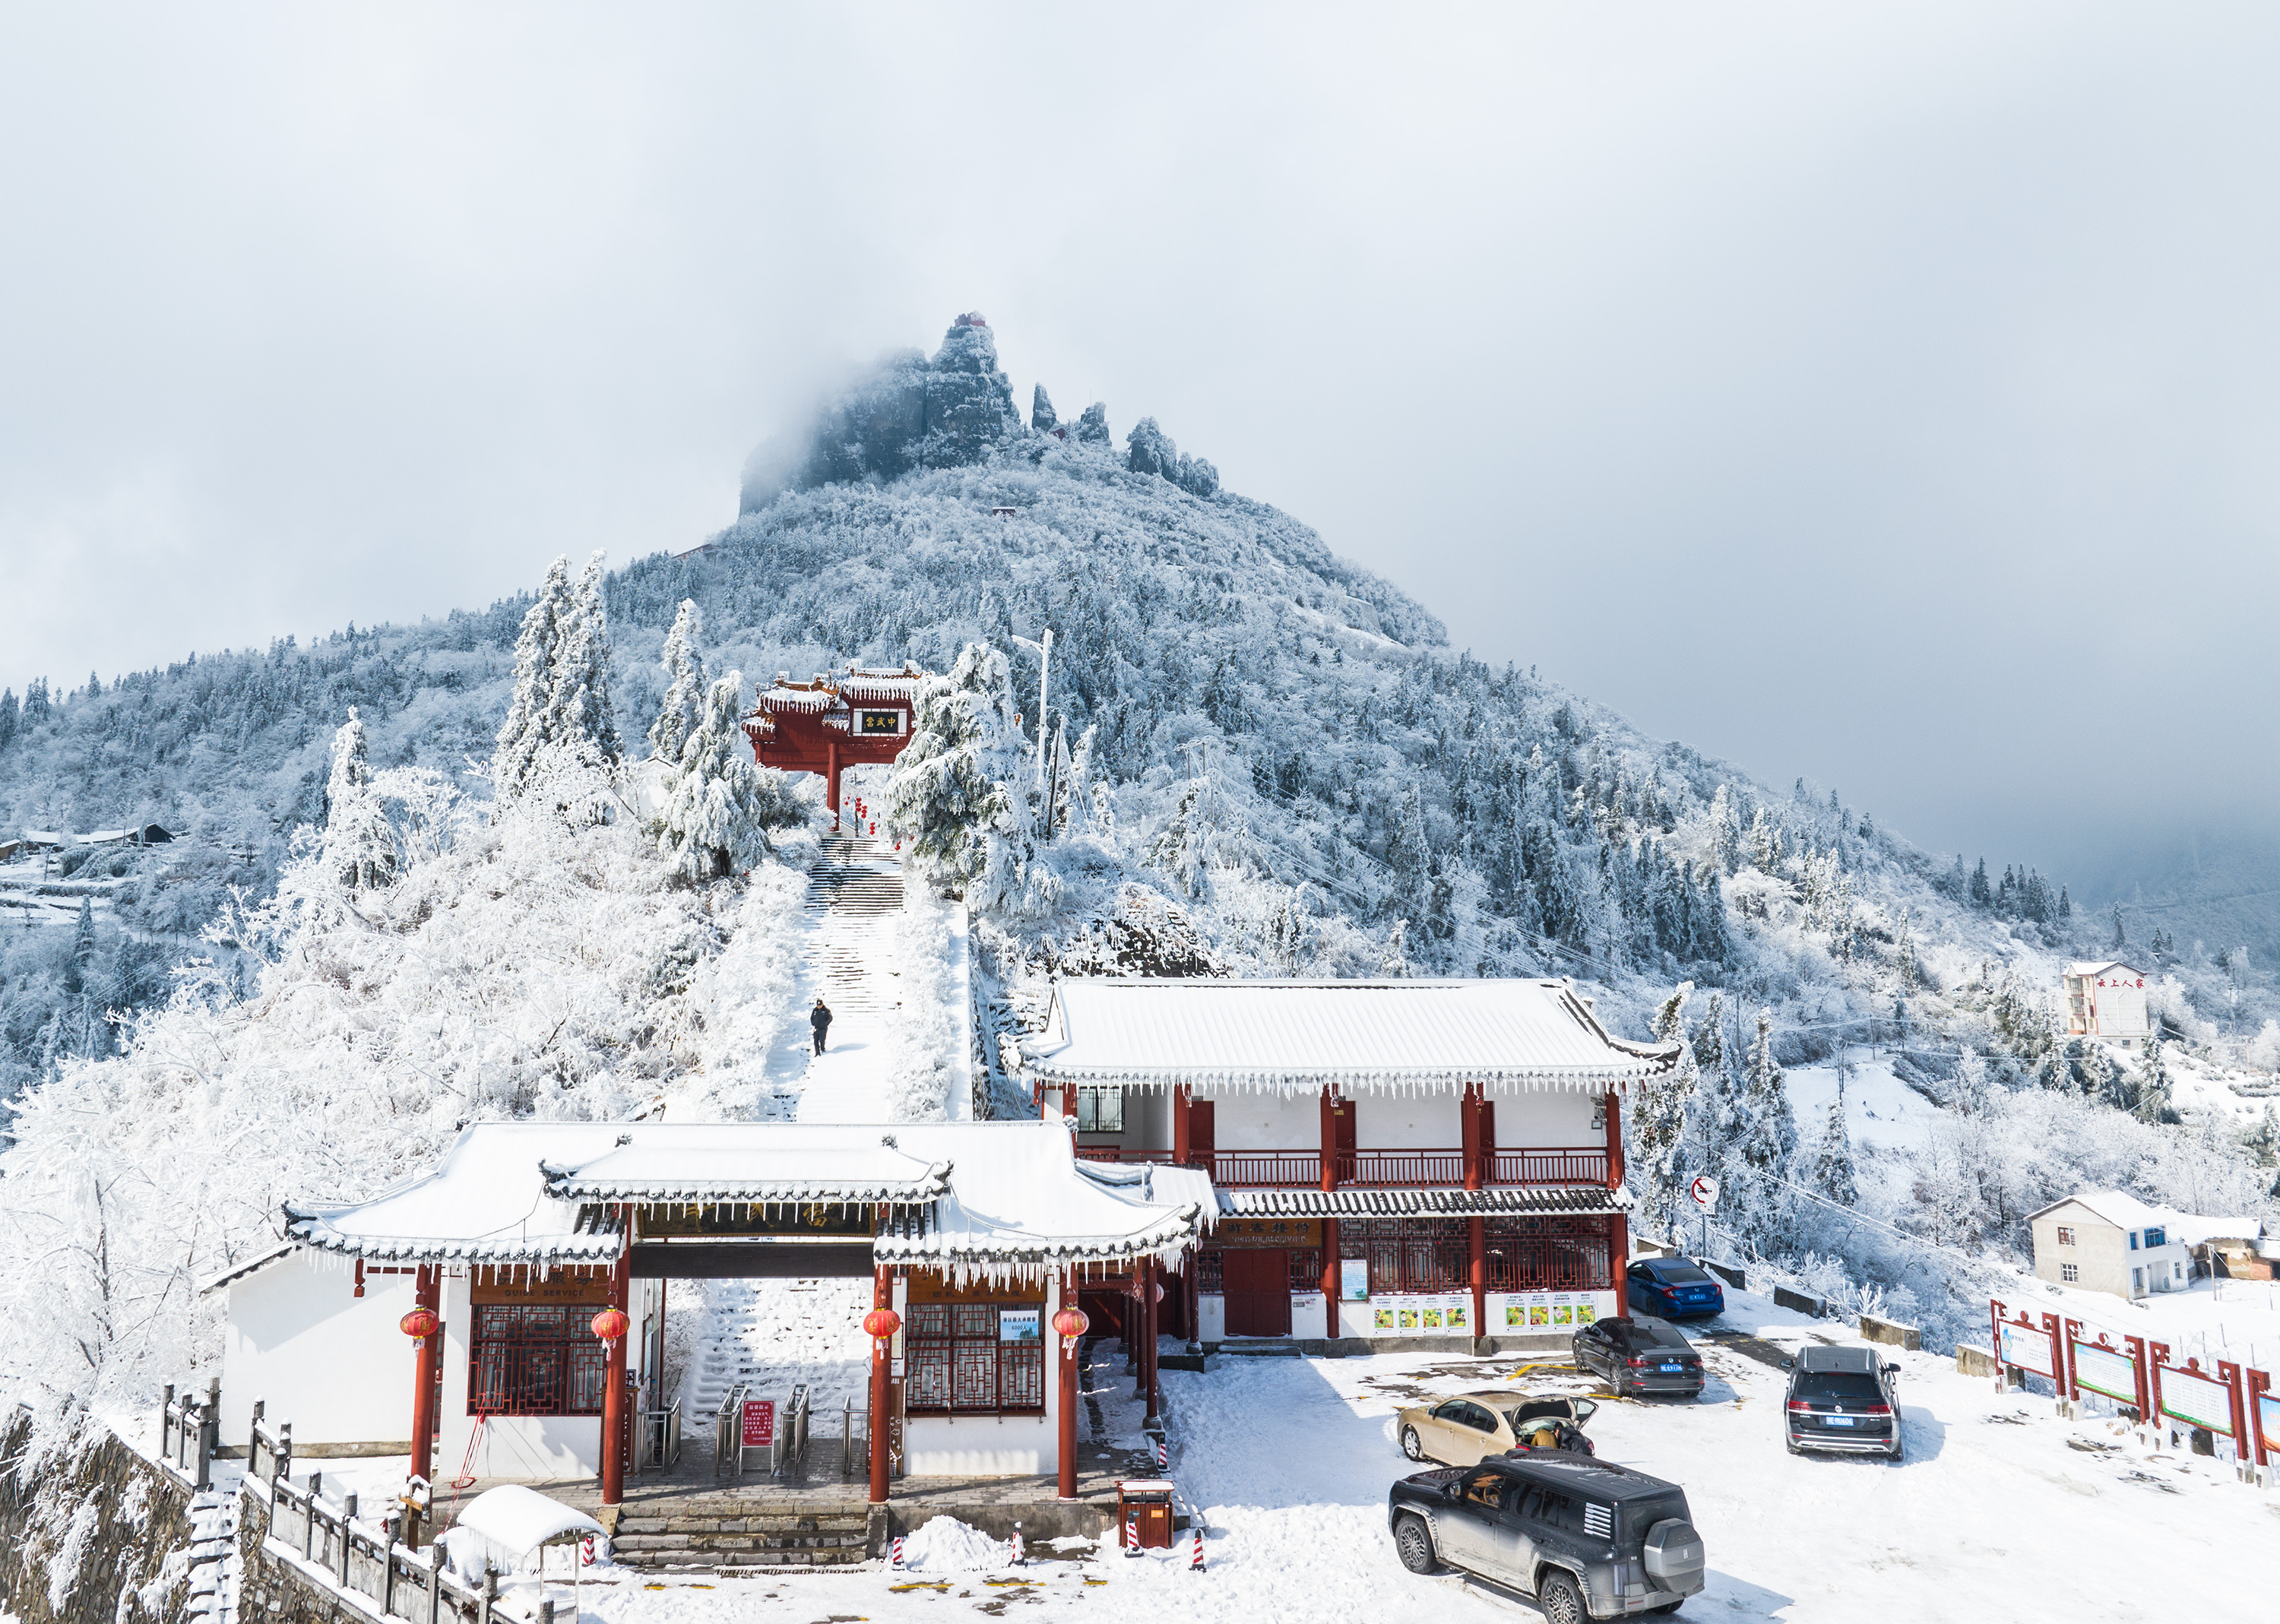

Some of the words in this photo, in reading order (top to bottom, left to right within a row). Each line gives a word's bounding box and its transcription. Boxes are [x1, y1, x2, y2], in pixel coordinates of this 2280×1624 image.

[2097, 978, 2145, 989] 云上人家
[1226, 1221, 1311, 1233] 游客接待
[492, 1271, 594, 1285] 导游服务
